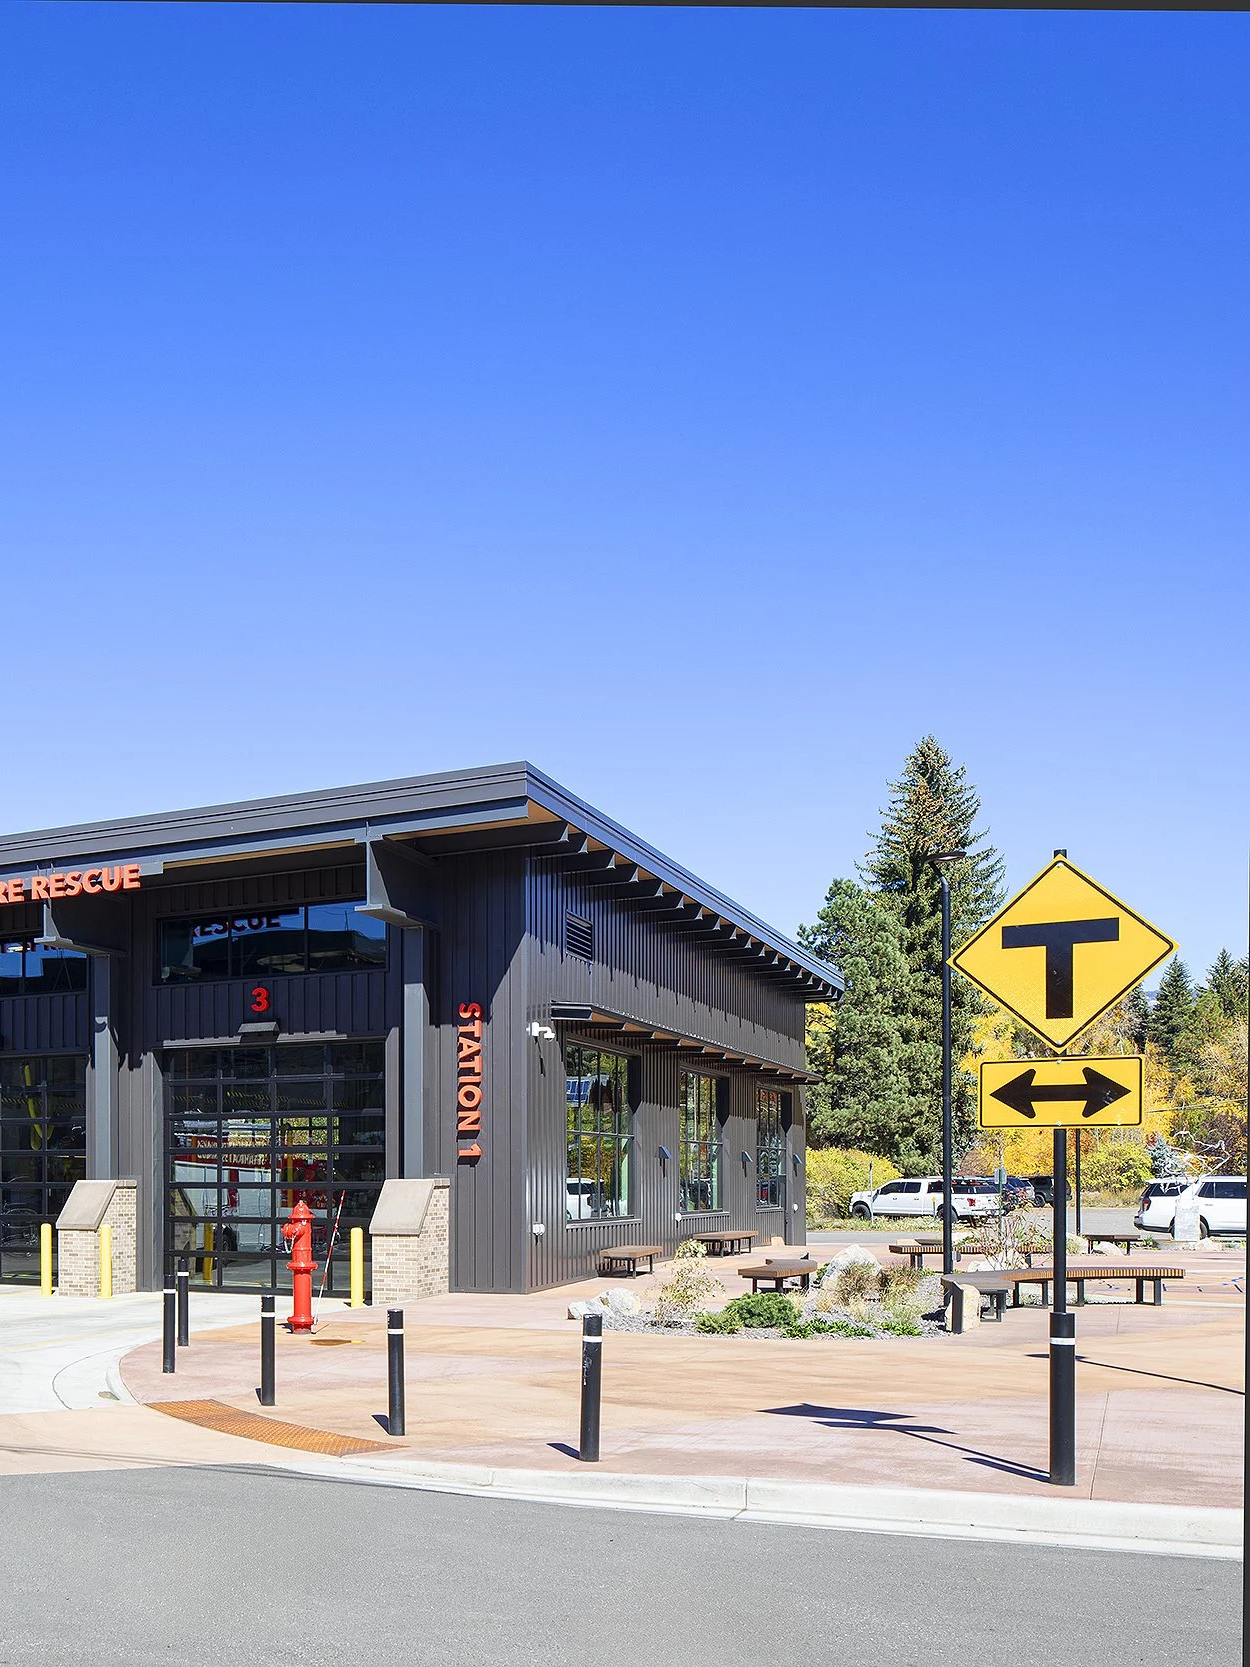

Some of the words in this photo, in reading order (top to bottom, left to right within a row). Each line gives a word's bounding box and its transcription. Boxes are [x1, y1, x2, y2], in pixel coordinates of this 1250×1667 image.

[31, 863, 141, 900] RESCUE
[251, 987, 269, 1012] 3
[458, 1002, 483, 1131] STATION
[458, 1143, 483, 1157] 1
